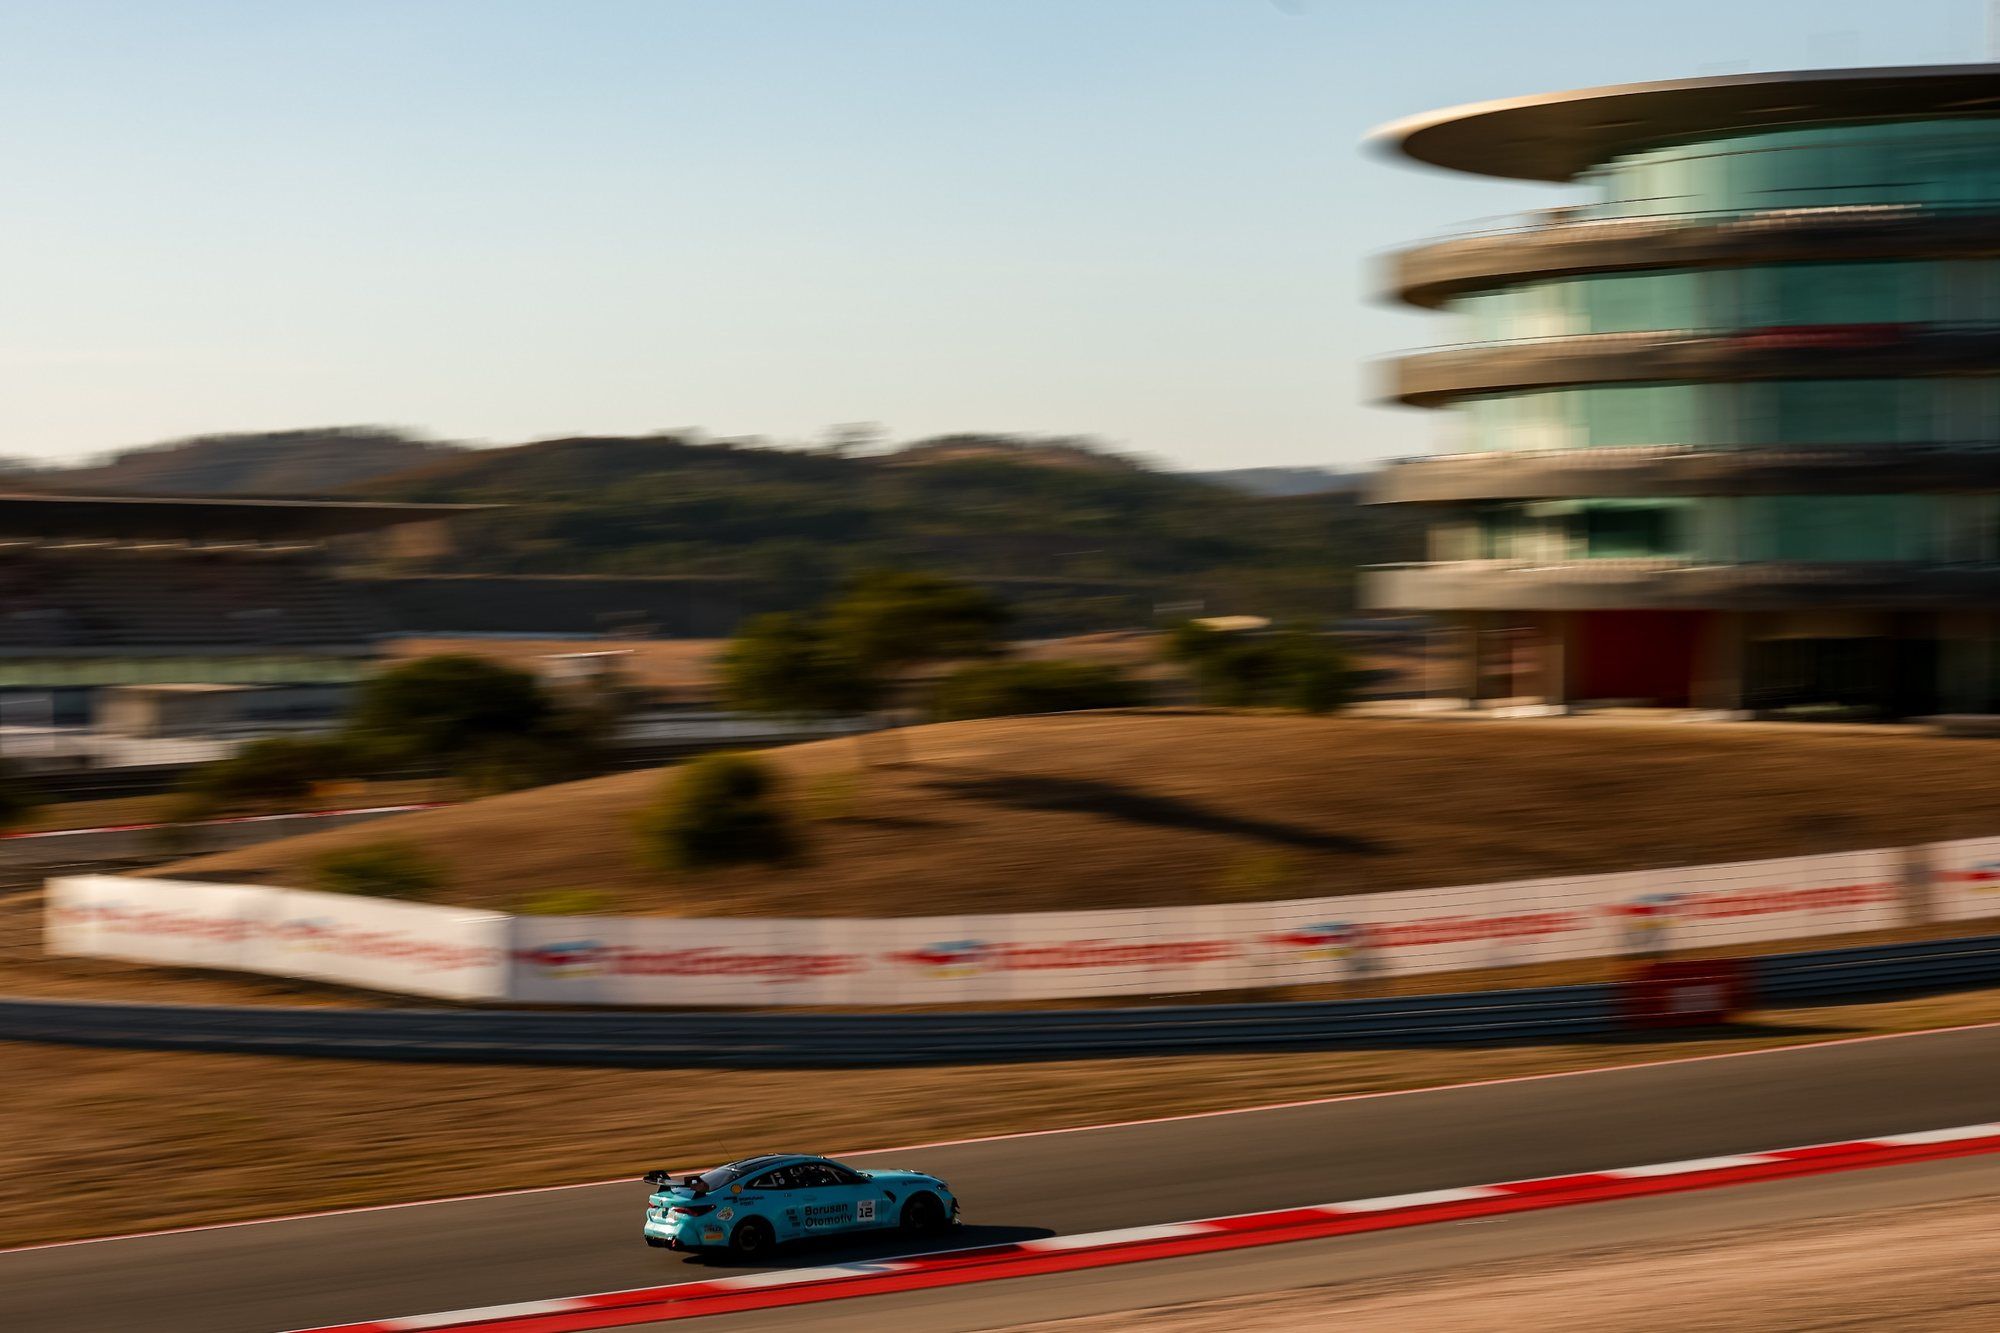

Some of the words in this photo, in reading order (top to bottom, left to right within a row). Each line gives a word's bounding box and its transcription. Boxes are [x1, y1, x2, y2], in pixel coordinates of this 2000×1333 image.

[805, 1203, 848, 1216] Borusan
[859, 1207, 873, 1218] 12
[805, 1214, 852, 1226] Otomotiv
